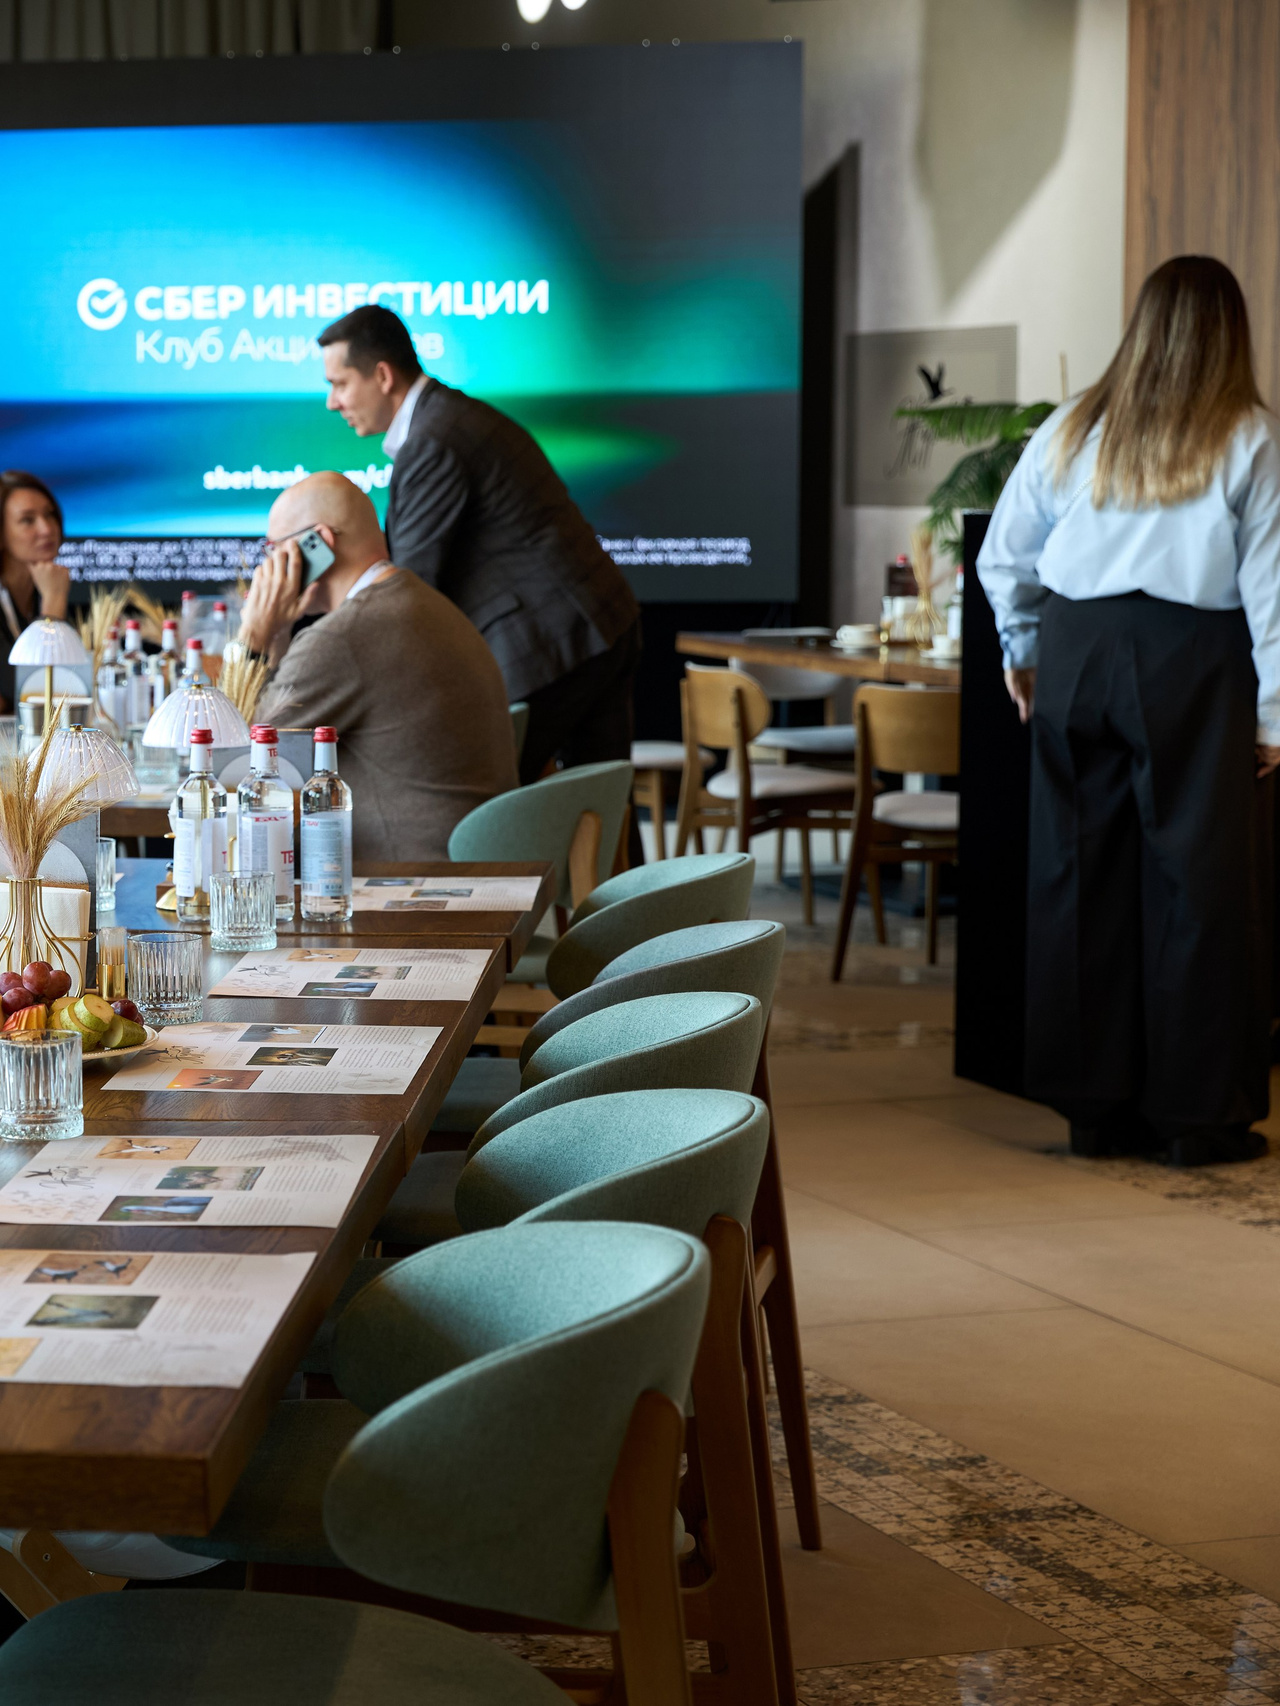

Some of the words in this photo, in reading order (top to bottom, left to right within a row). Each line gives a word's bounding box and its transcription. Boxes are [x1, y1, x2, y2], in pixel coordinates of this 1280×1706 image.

[134, 285, 246, 320] СБЕР
[253, 280, 550, 320] ИНВЕСТИЦИИ
[136, 326, 224, 371] Клуб
